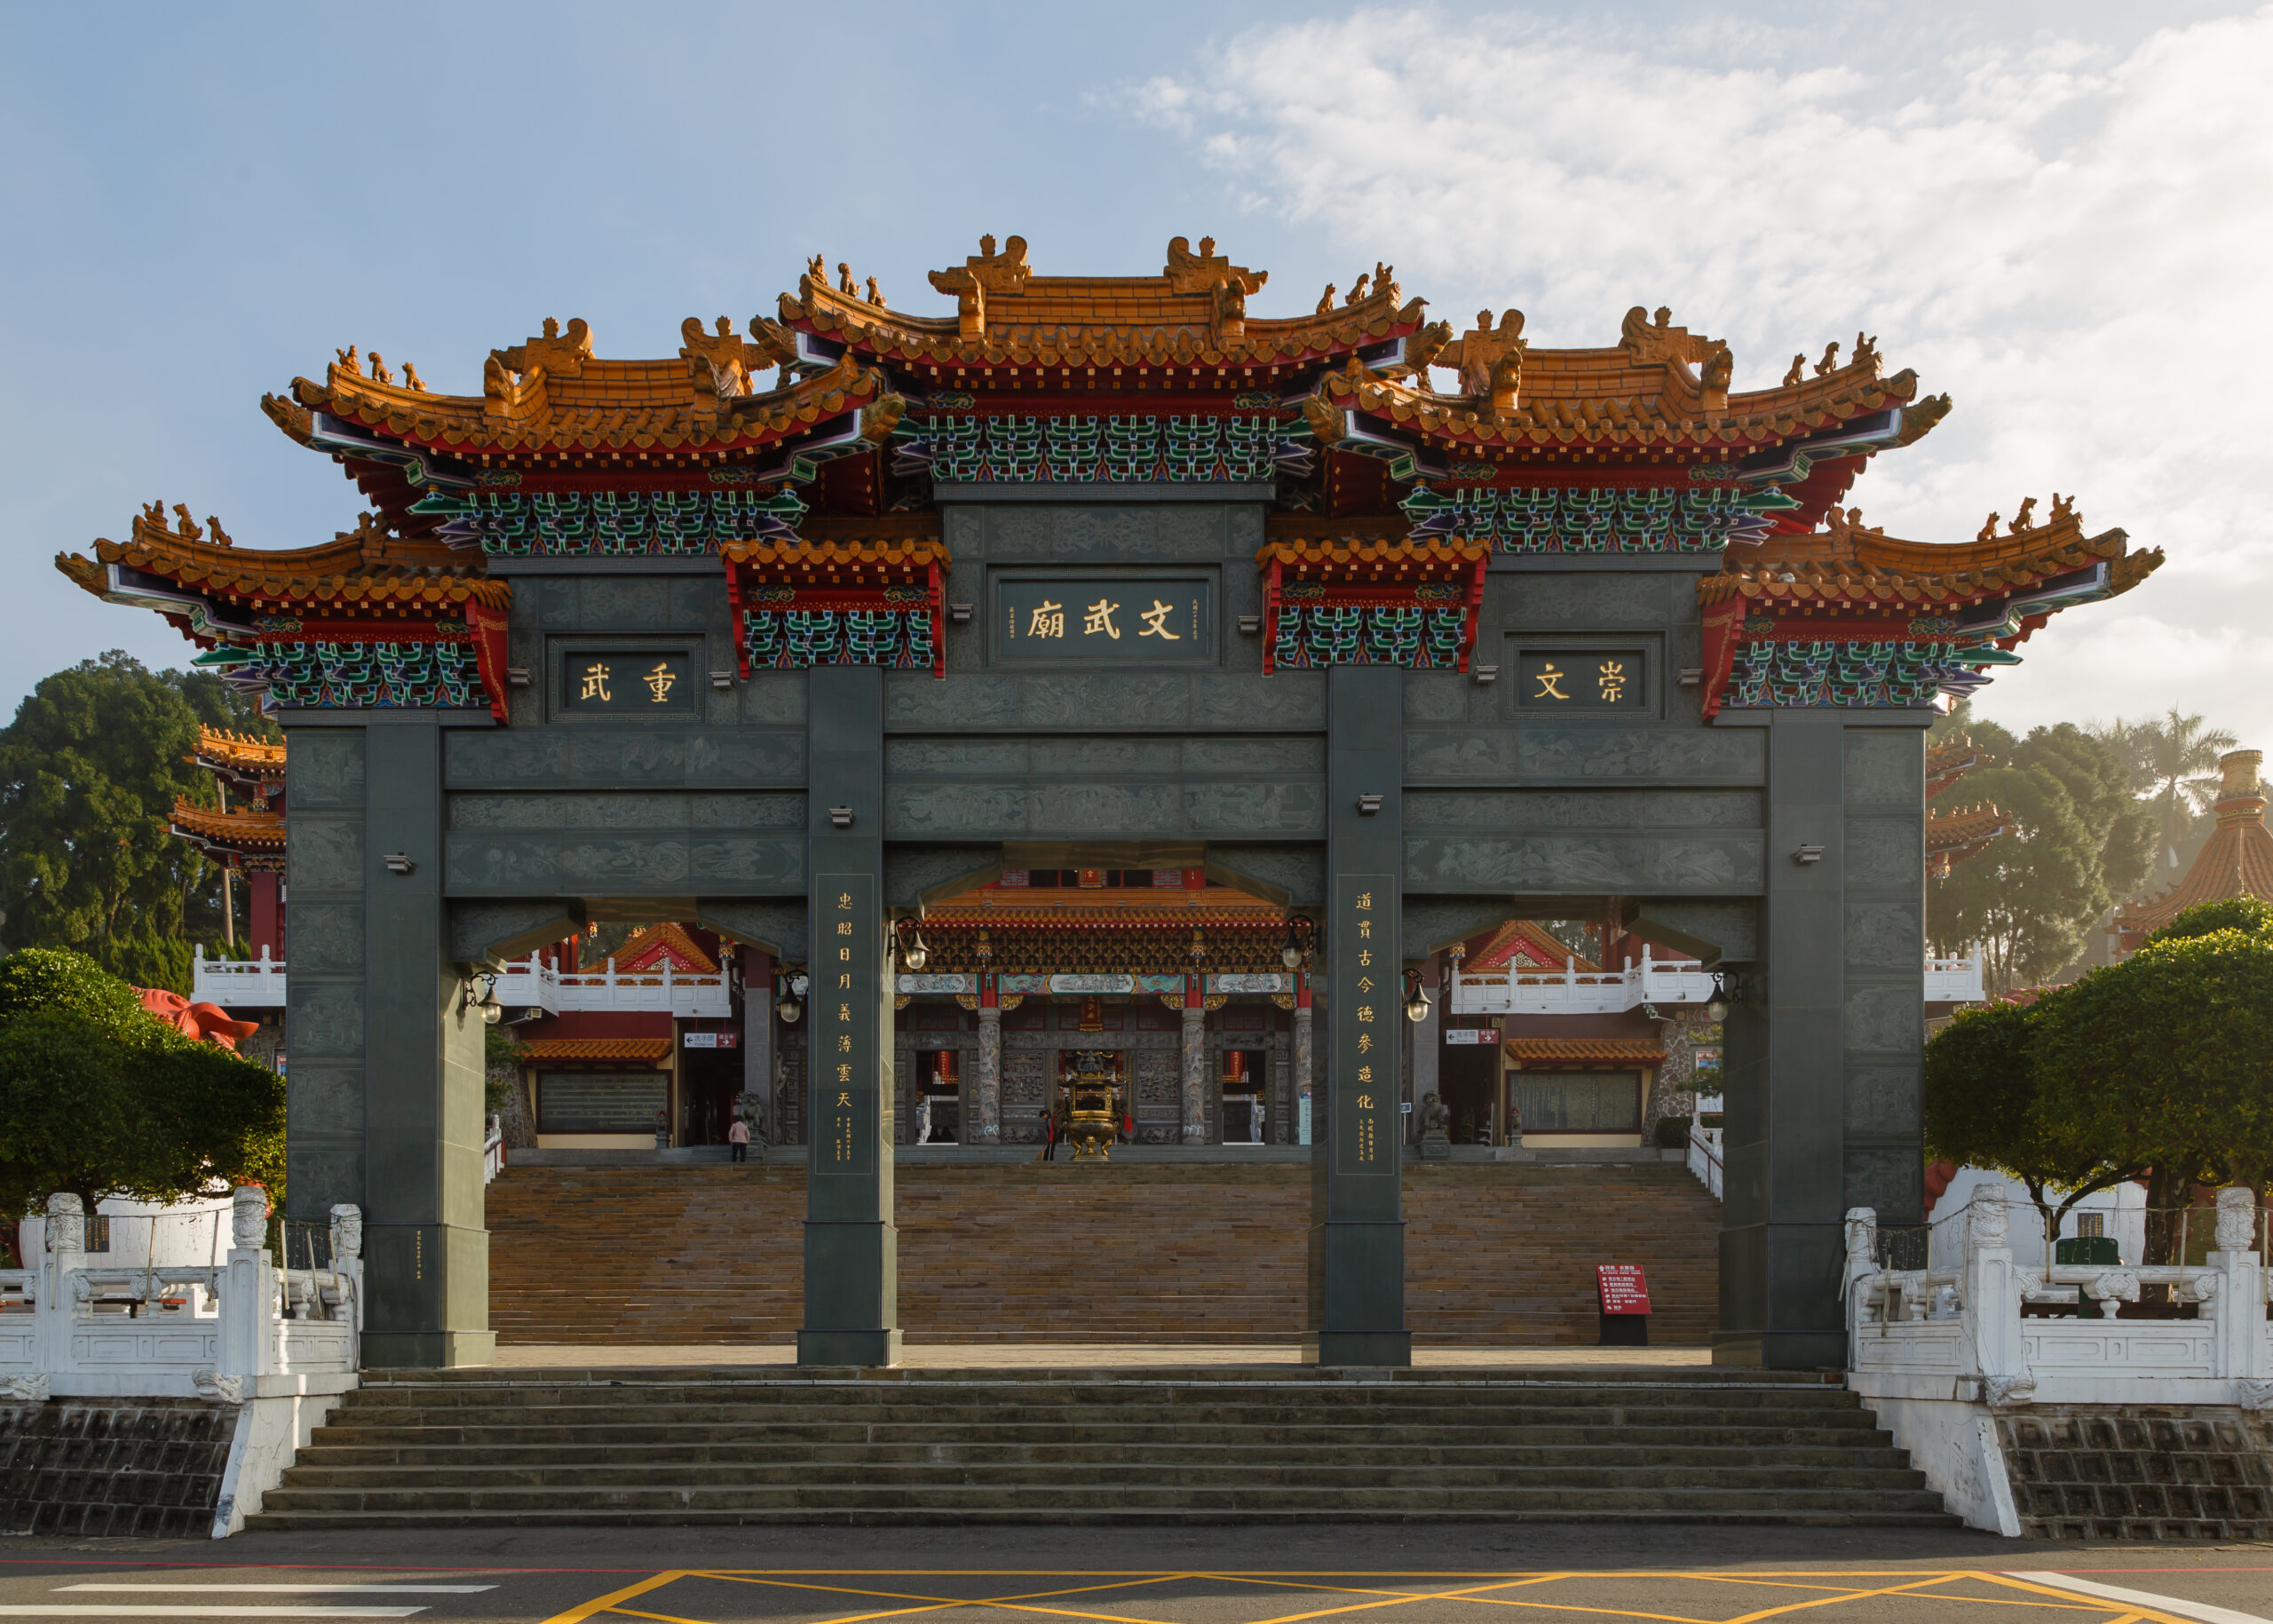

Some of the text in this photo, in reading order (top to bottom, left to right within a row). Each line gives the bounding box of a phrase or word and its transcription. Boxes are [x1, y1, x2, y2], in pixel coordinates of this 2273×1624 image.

[1027, 598, 1180, 639] 文武廟
[1533, 661, 1627, 702] 崇文
[836, 892, 853, 1108] 忠昭日月義薄雲天
[1356, 891, 1375, 1110] 道貫古今德參造化
